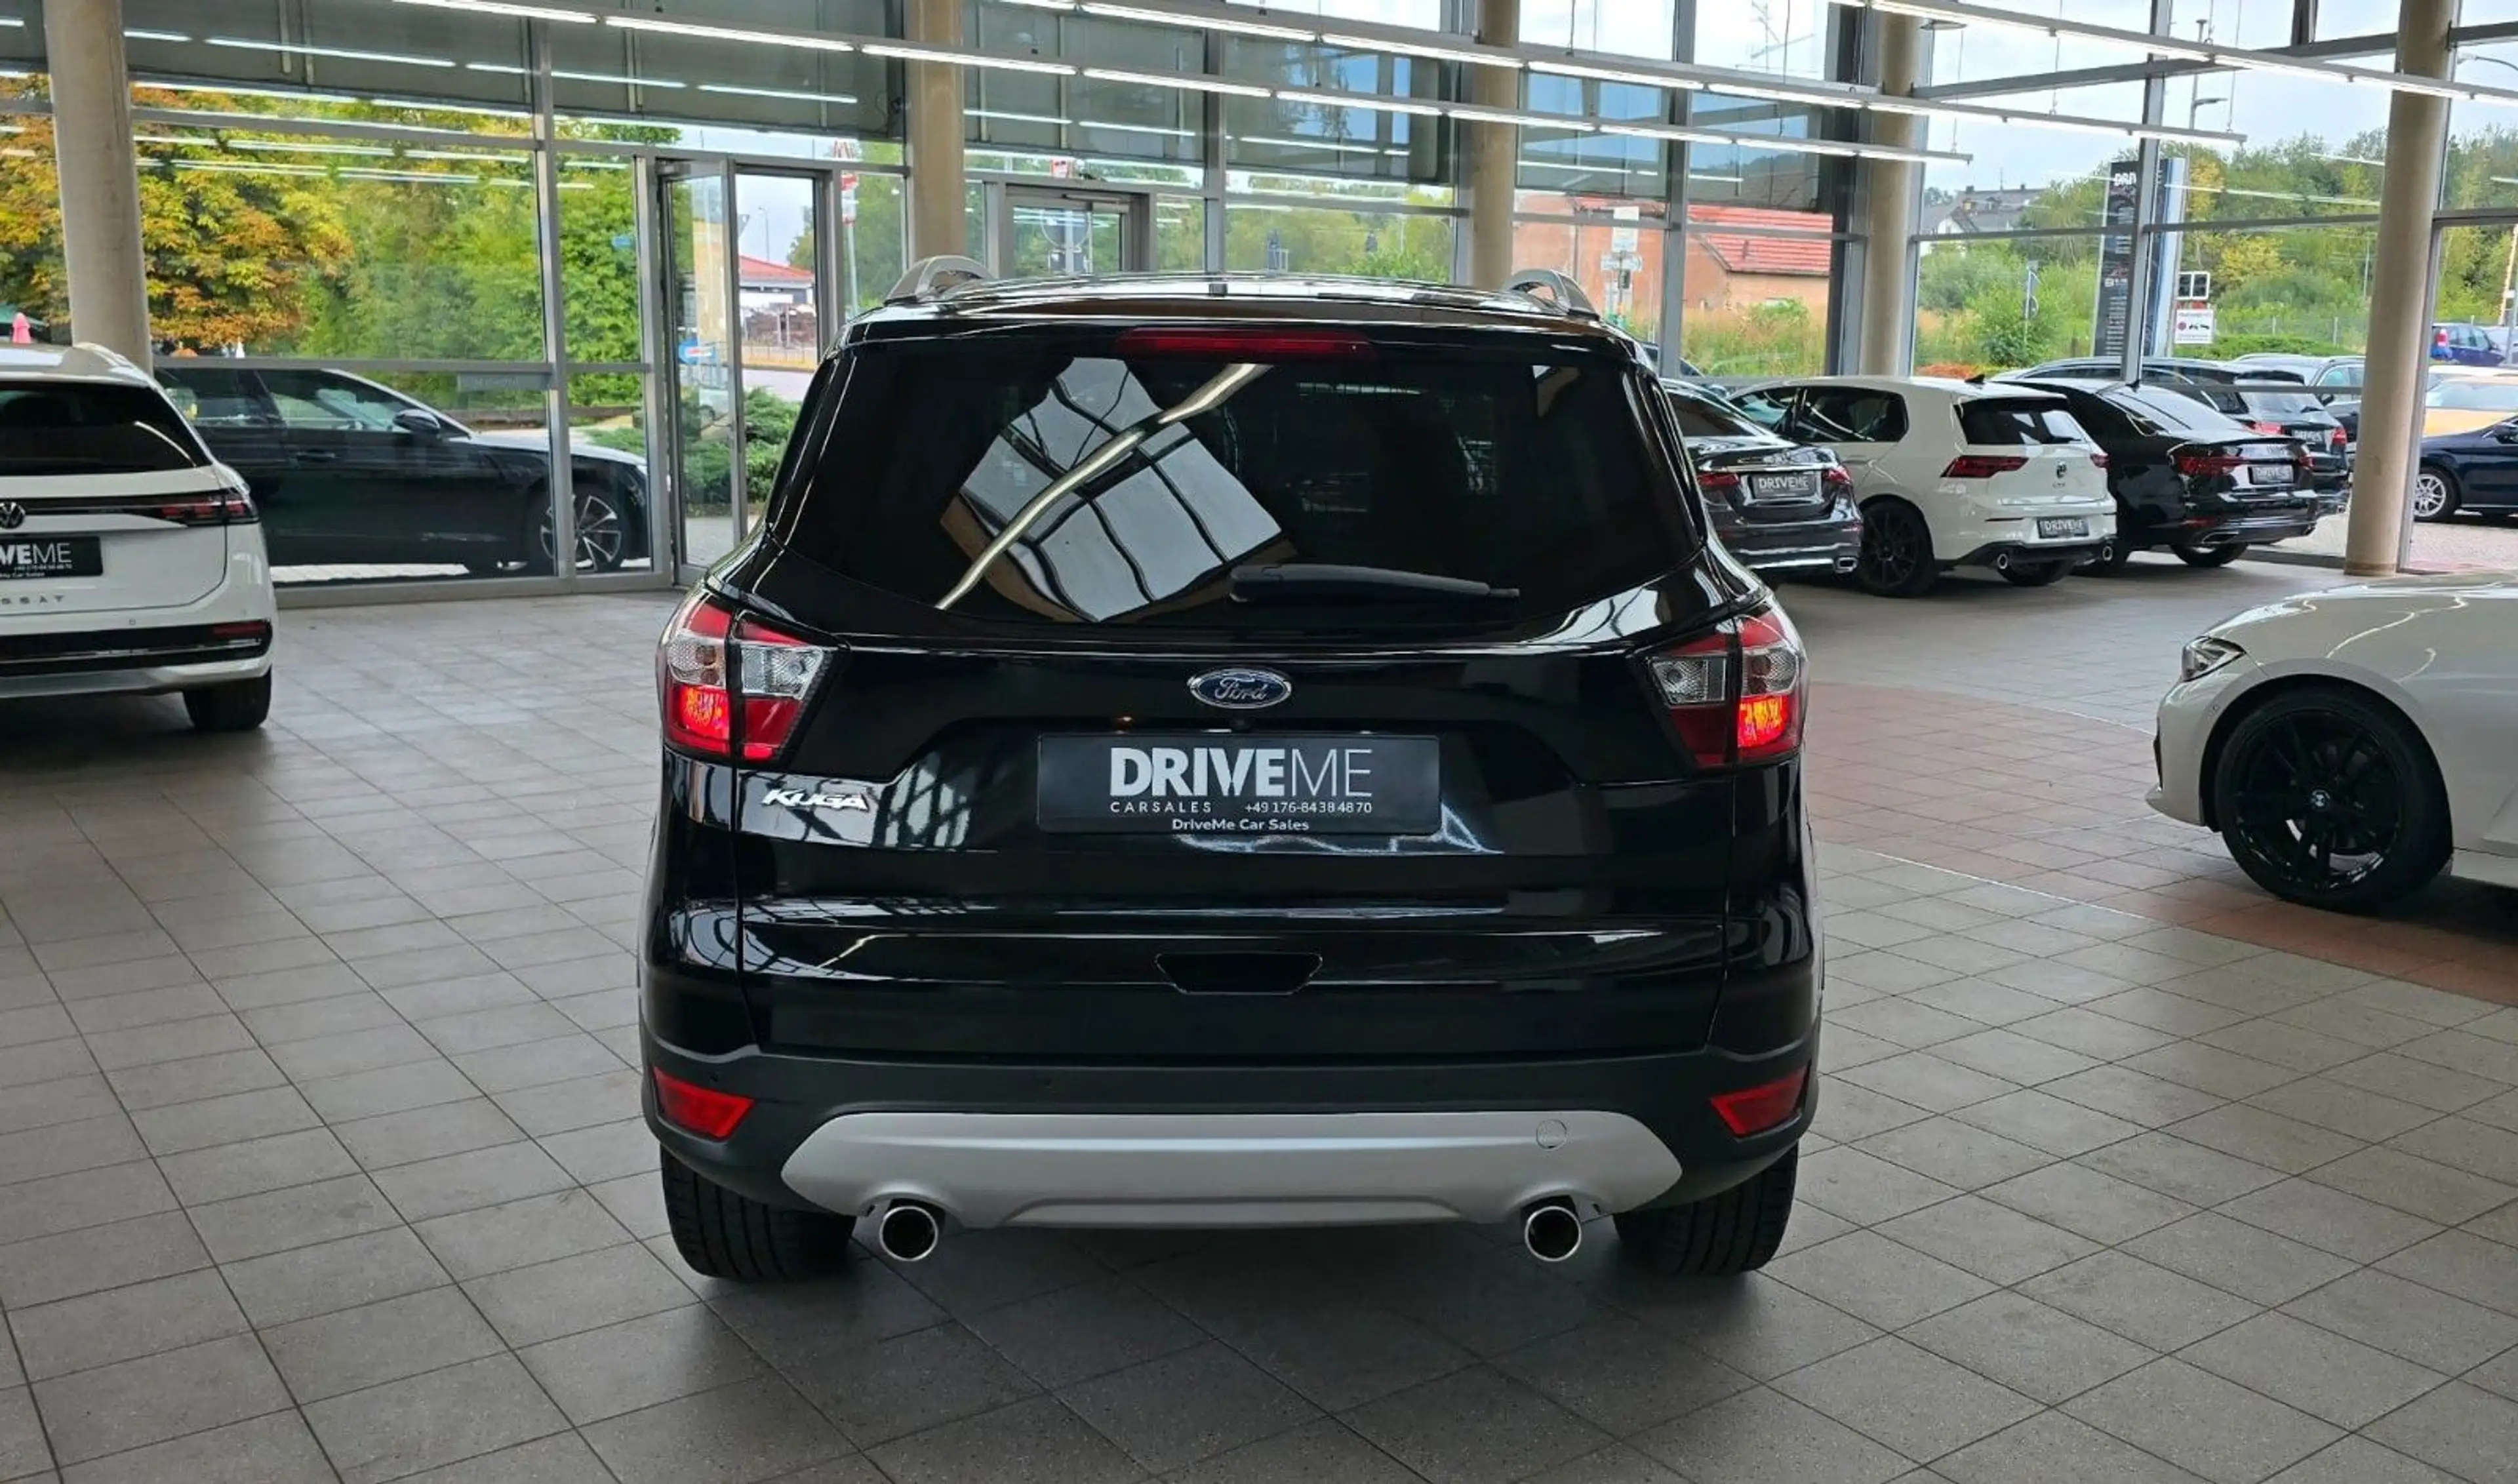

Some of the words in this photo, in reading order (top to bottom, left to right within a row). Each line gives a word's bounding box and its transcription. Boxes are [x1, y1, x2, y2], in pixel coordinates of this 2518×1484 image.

[1214, 677, 1269, 700] Ford
[1109, 747, 1372, 797] DRIVEME
[761, 788, 870, 812] KUGA
[1110, 801, 1211, 813] CARSALES
[1172, 818, 1235, 830] DriveMe
[1239, 818, 1265, 830] Car
[1268, 818, 1309, 831] Sales
